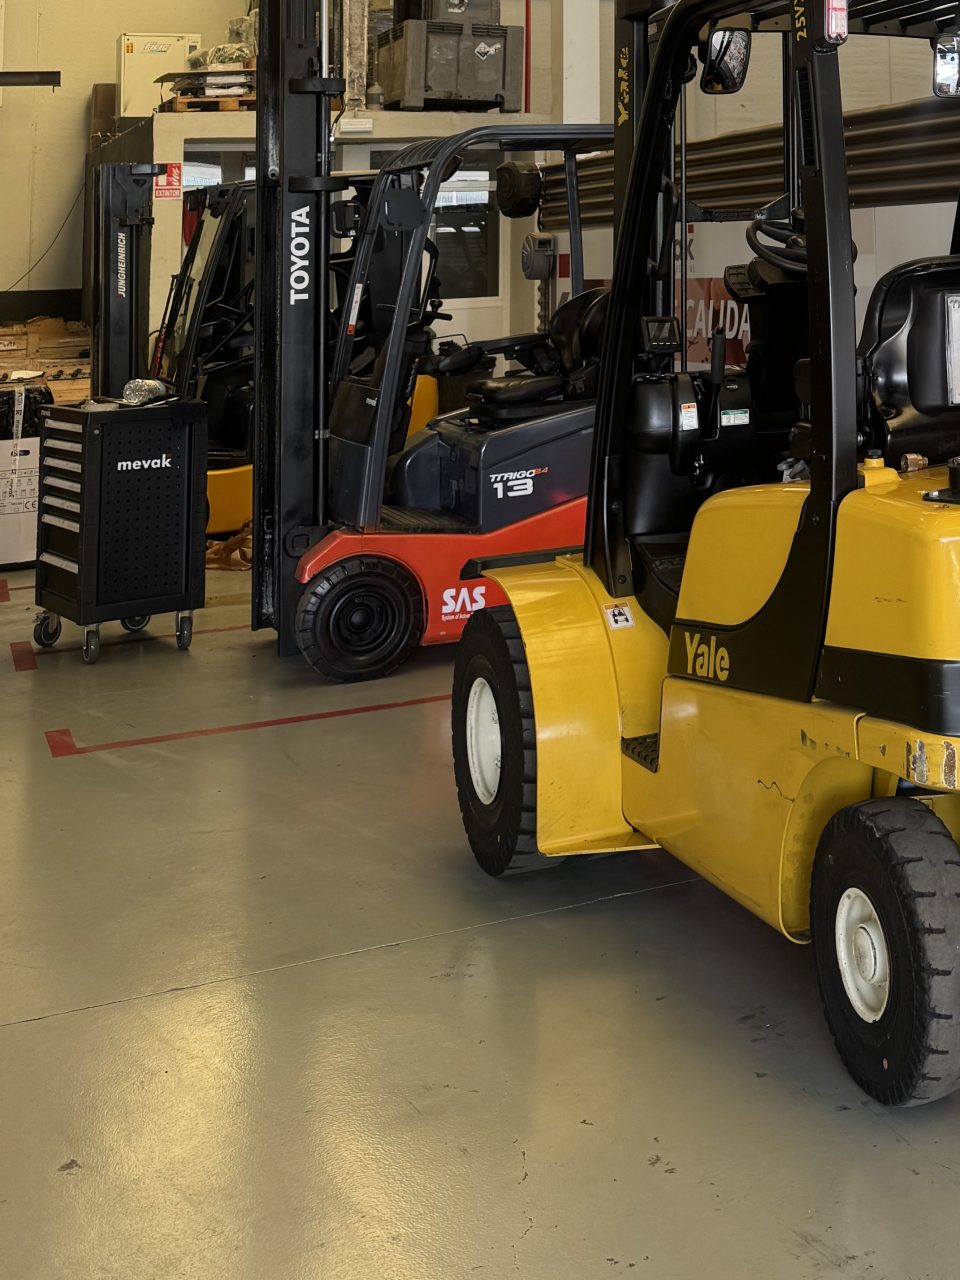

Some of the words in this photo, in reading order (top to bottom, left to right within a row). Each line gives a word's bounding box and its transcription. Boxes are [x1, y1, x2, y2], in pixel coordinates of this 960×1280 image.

[155, 189, 180, 197] EXTINTOR
[117, 232, 126, 298] JUNGHEINRICH
[289, 205, 310, 306] TOYOTA
[686, 299, 751, 341] CALIDA
[117, 453, 172, 471] mevak
[493, 478, 534, 499] 13
[441, 586, 486, 614] SAS
[684, 631, 730, 681] Yale
